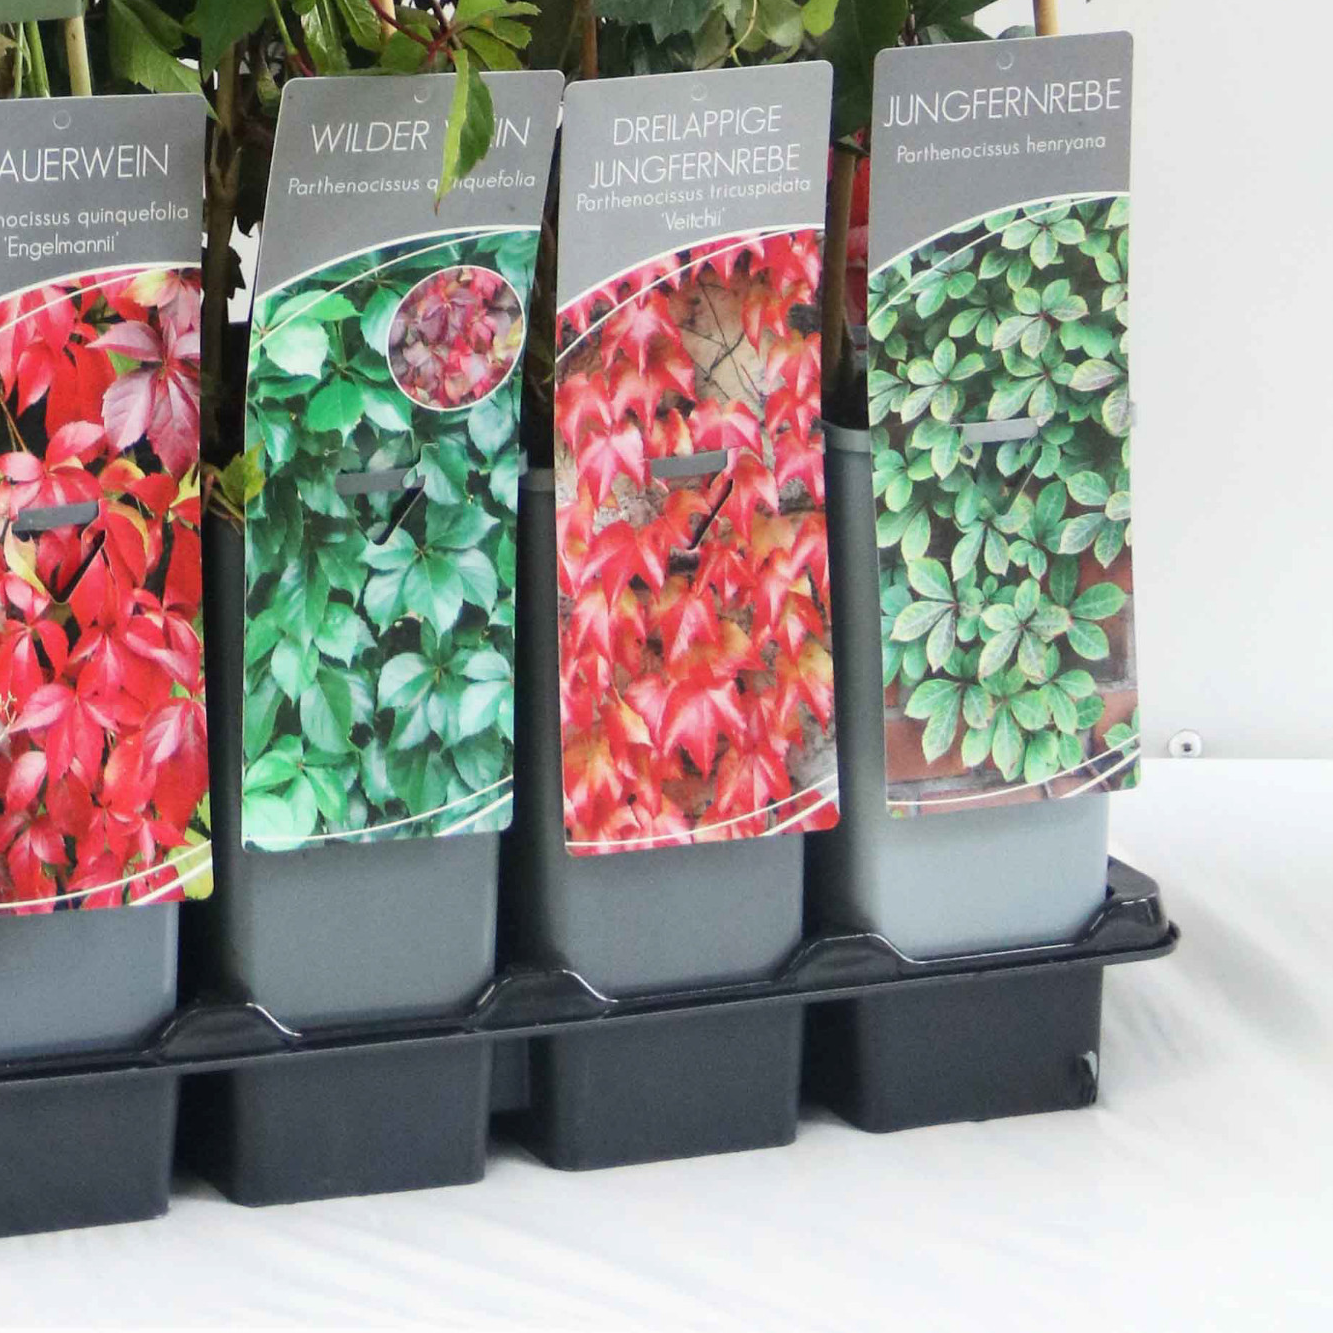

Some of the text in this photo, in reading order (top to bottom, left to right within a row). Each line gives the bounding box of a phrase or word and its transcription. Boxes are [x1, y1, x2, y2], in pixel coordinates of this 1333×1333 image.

[883, 78, 1122, 128] JUNGFERNREBE
[311, 120, 431, 154] WILDER
[613, 105, 783, 145] DREILAPPIGE
[589, 144, 801, 189] JUNGFERNREBE
[897, 135, 1106, 163] Parthenocissus henryana
[288, 177, 420, 195] Parthenocissus
[576, 174, 811, 212] Parthenocissus tricuspidata
[78, 201, 189, 227] quinquefolia
